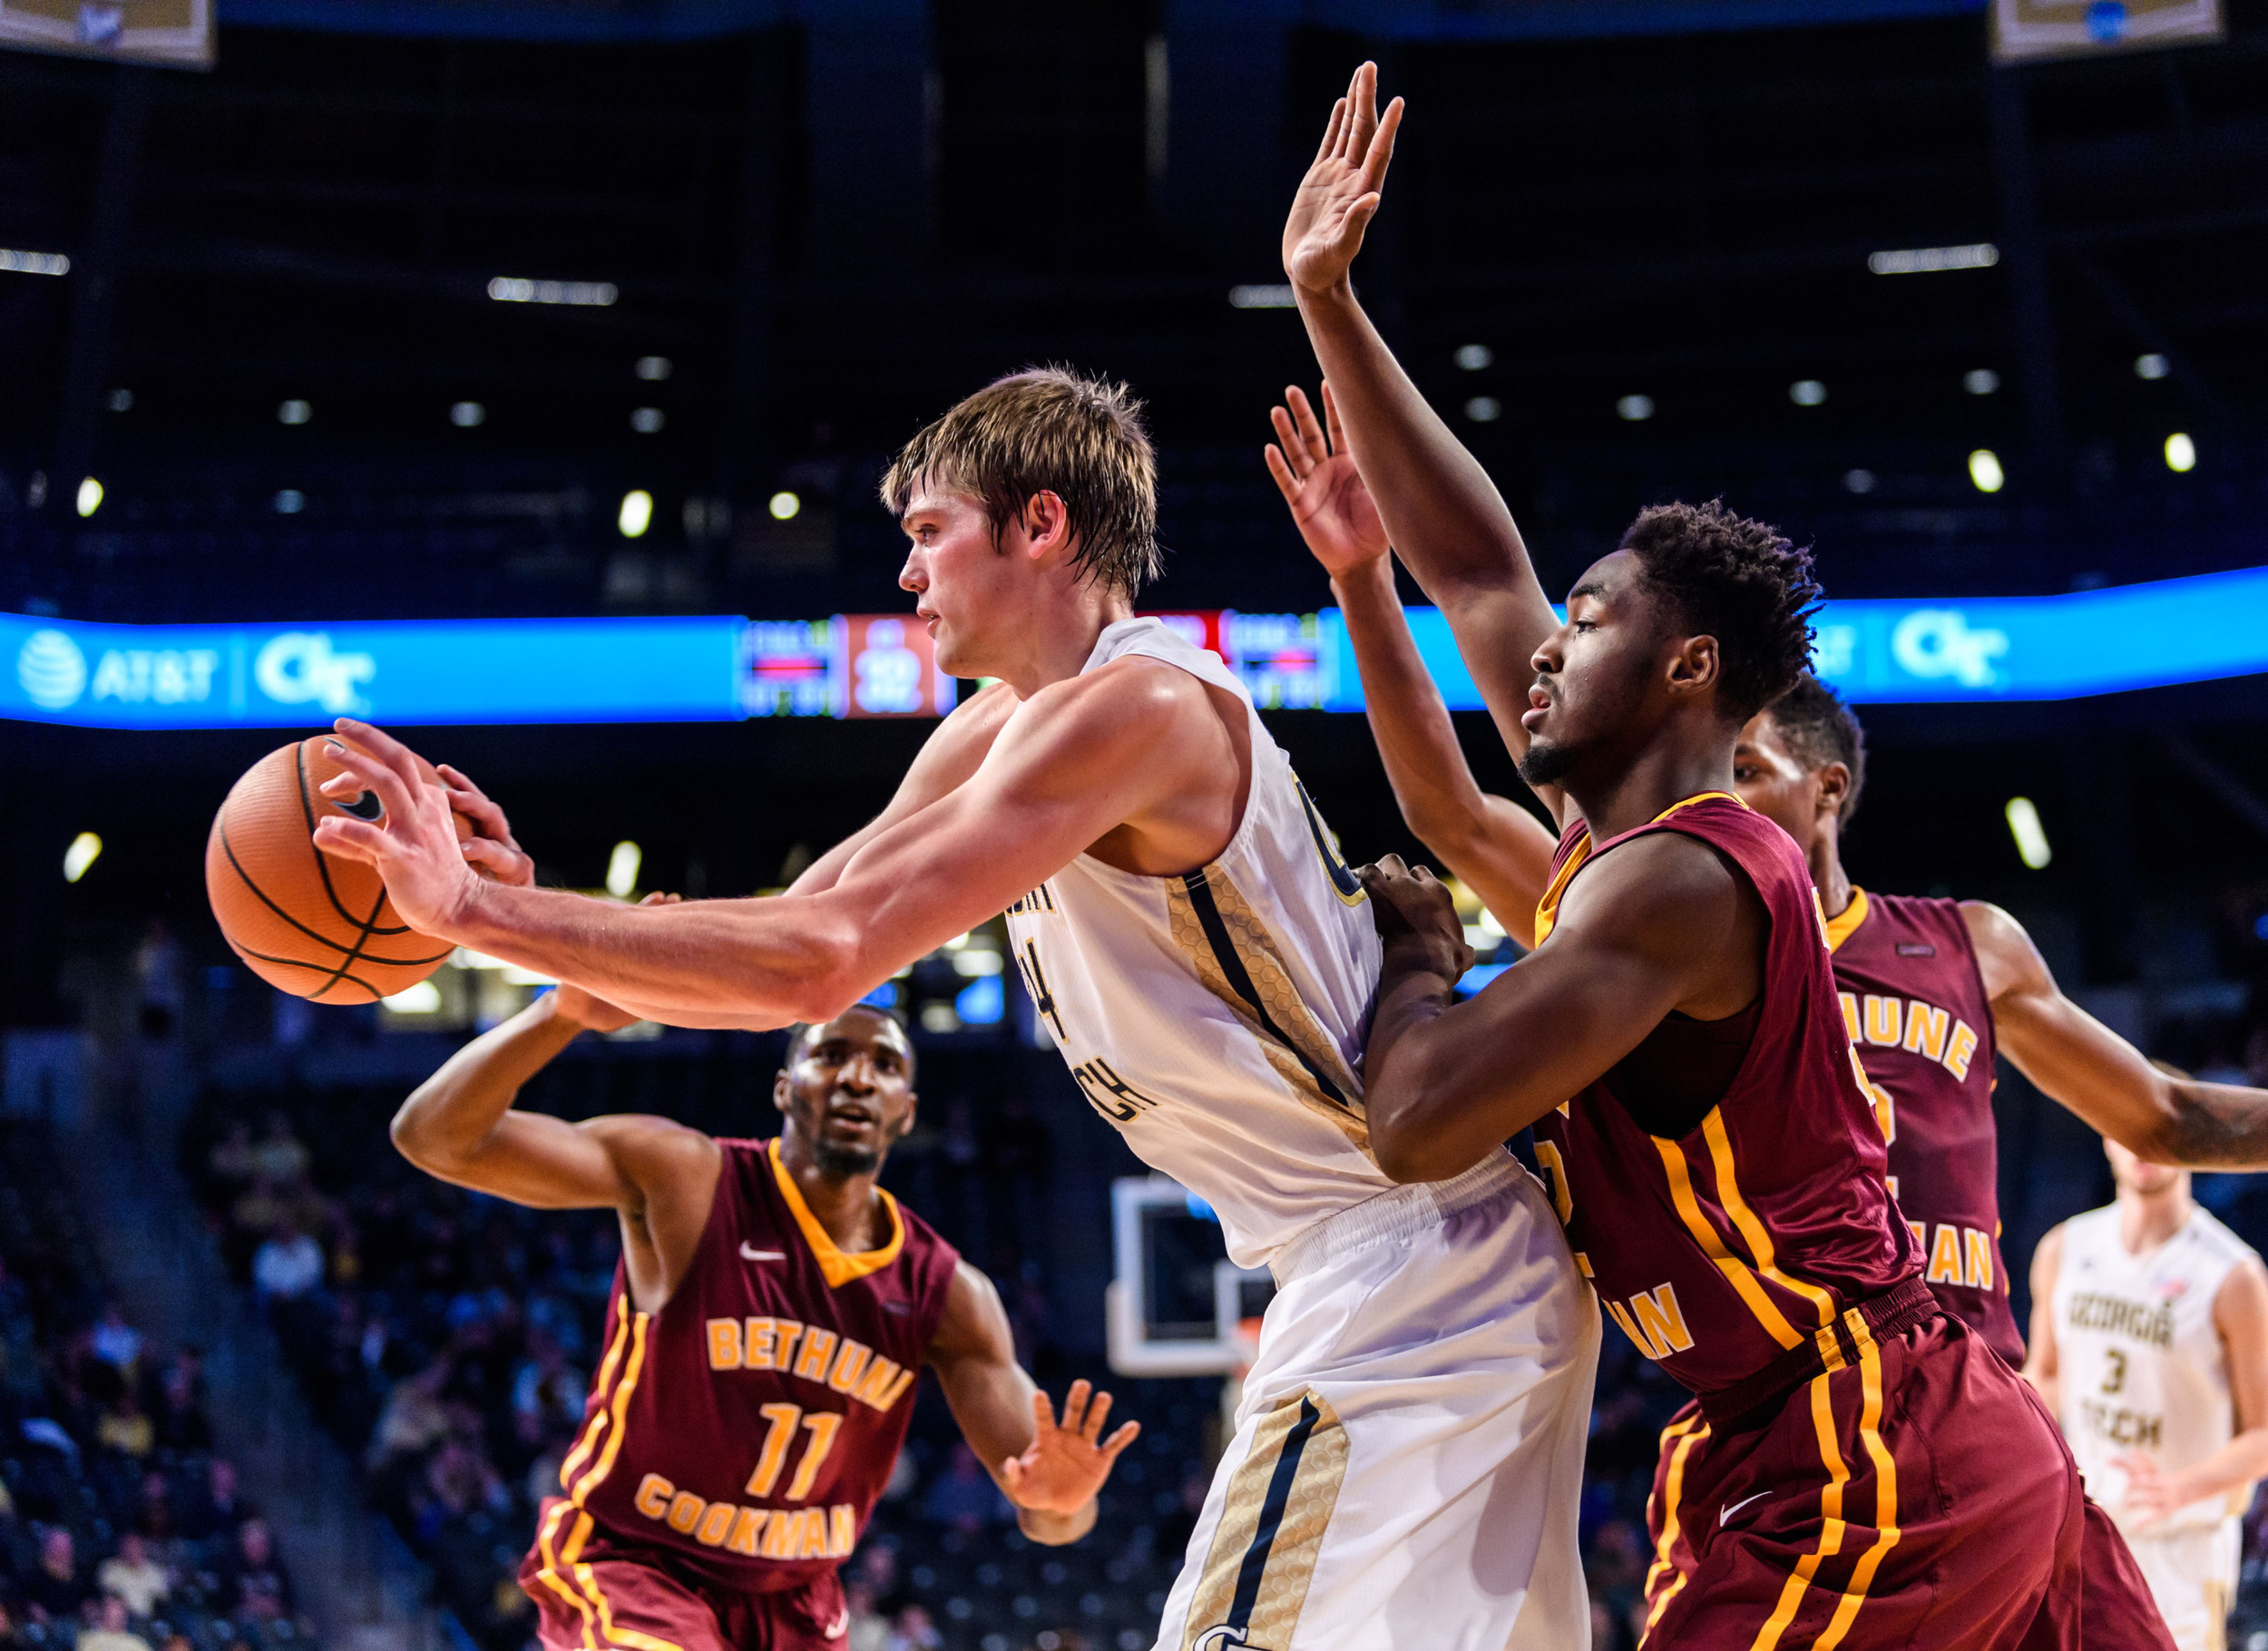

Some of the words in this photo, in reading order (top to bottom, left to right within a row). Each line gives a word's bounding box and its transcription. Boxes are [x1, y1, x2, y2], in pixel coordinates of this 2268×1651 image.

[706, 1315, 915, 1412] BETHUN
[2100, 1345, 2128, 1395] 3
[745, 1402, 845, 1501] 11
[634, 1472, 856, 1560] COOKMAN
